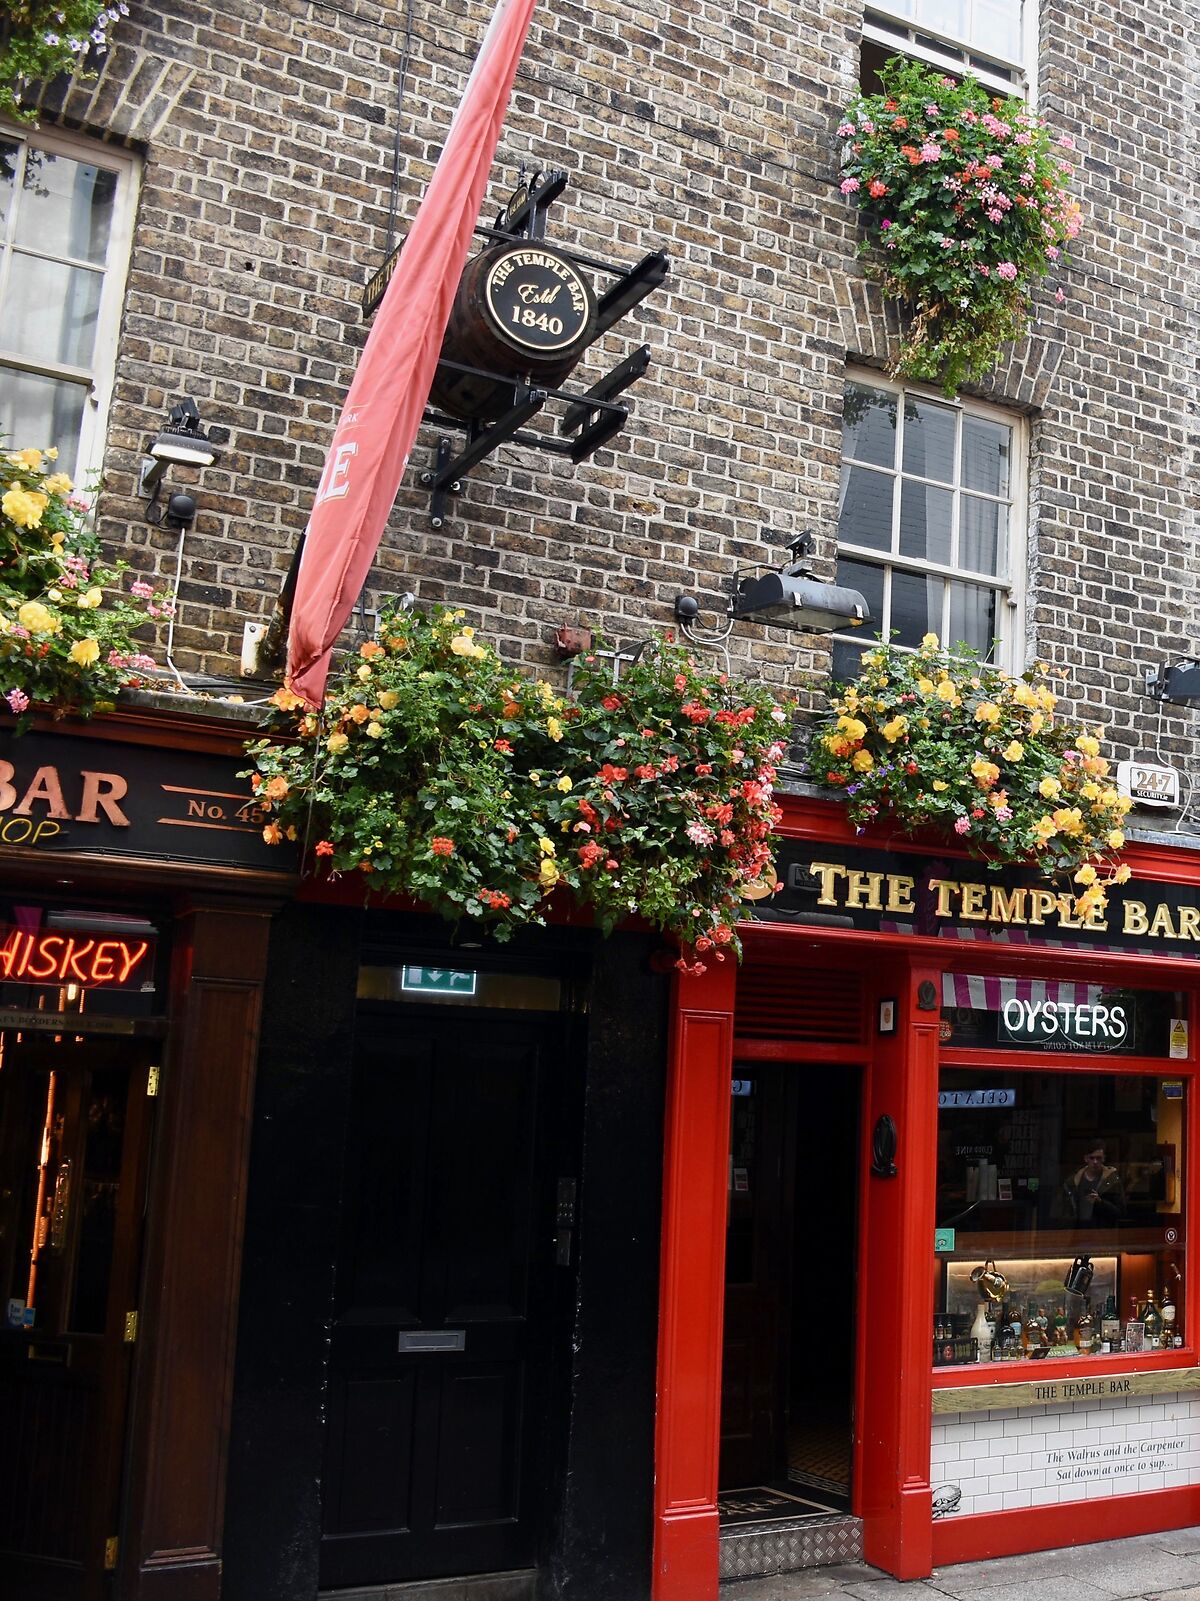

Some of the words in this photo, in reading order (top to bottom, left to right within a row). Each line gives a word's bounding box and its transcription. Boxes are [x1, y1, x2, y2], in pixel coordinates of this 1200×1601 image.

[493, 260, 515, 286] THE
[513, 254, 570, 281] TEMPLE
[567, 281, 584, 311] BAR
[518, 284, 561, 304] Estd
[512, 306, 563, 335] 1840
[187, 800, 228, 820] No.
[0, 817, 61, 844] OP
[809, 861, 915, 914] THE
[927, 878, 1109, 932] TEMPLE
[1003, 998, 1127, 1039] OYSTERS
[1035, 1386, 1057, 1399] THE
[1062, 1382, 1105, 1397] TEMPLE
[1110, 1379, 1131, 1392] BAR
[1046, 1453, 1063, 1464] The
[1067, 1449, 1100, 1461] Walrus
[1103, 1444, 1120, 1457] and
[1124, 1443, 1137, 1455] the
[1140, 1439, 1185, 1456] Carpenter
[1056, 1469, 1071, 1481] Sat
[1074, 1466, 1099, 1478] down
[1102, 1465, 1111, 1475] at
[1114, 1463, 1134, 1473] once
[1137, 1462, 1146, 1471] to
[1149, 1459, 1173, 1470] sup...
